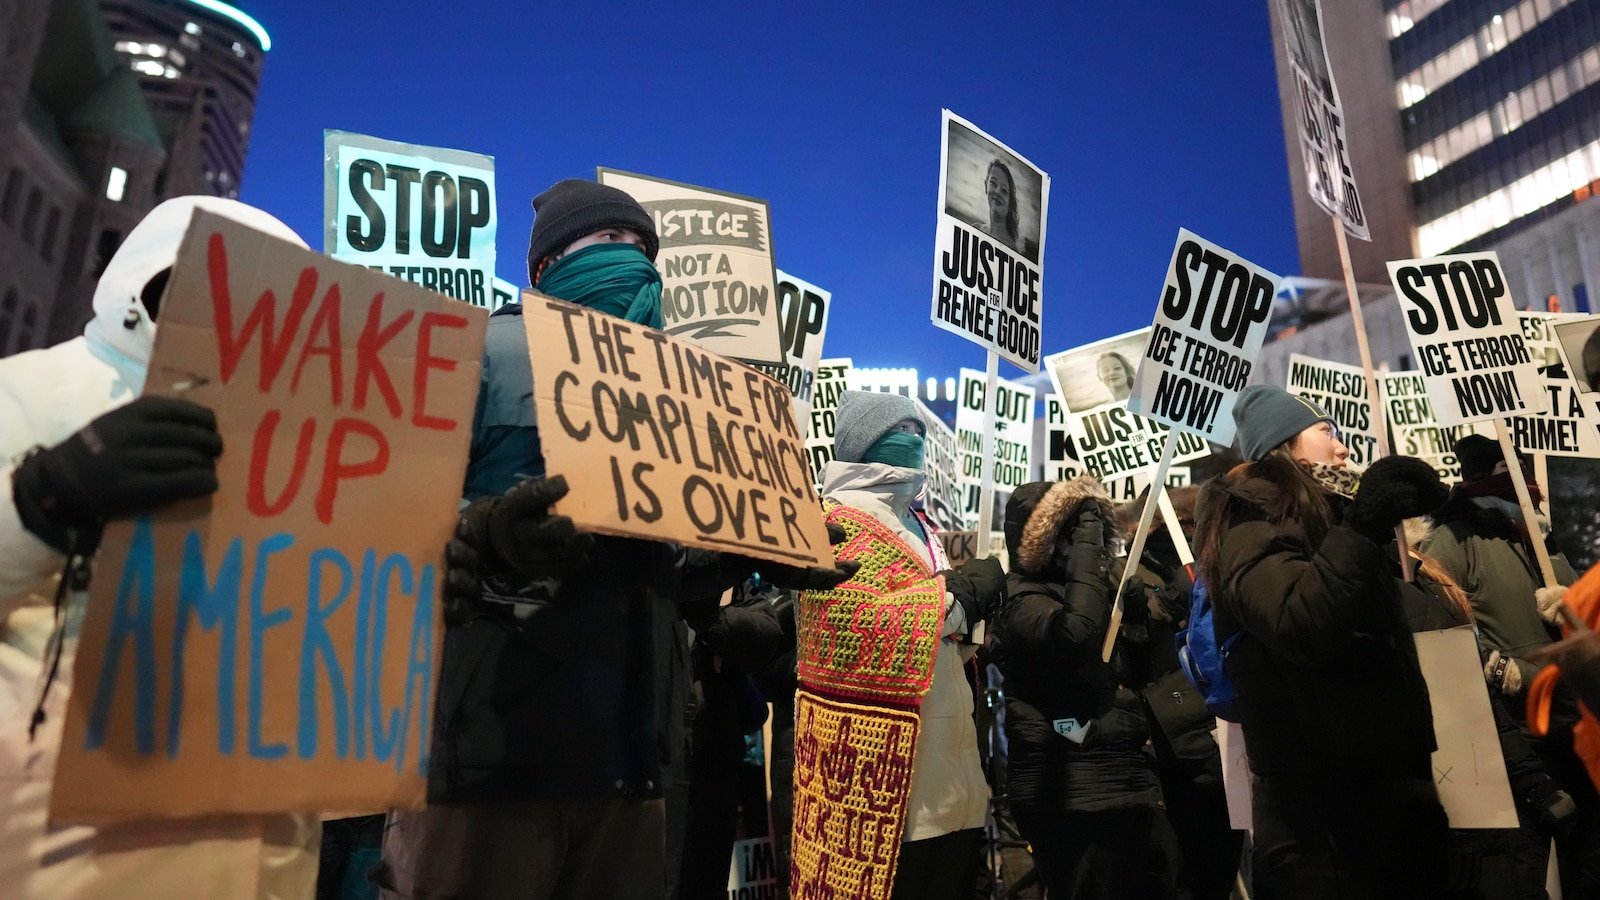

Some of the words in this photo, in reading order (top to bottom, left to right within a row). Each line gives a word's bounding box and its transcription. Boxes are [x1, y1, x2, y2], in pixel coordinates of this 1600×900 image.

[346, 158, 490, 260] STOP
[665, 253, 712, 278] NOT
[715, 253, 732, 276] A
[942, 225, 1040, 324] JUSTICE
[989, 291, 1000, 308] FOR
[1162, 240, 1275, 349] STOP
[1396, 259, 1505, 336] STOP
[208, 233, 468, 431] WAKE
[662, 280, 769, 325] MOTION
[937, 279, 994, 342] RENEE
[997, 309, 1040, 365] GOOD
[546, 302, 641, 382] THE
[643, 330, 743, 417] TIME
[744, 372, 800, 440] FOR
[1146, 323, 1182, 367] ICE
[1180, 336, 1252, 393] TERROR
[1291, 362, 1380, 401] MINNESOT
[1418, 344, 1457, 377] ICE
[1453, 334, 1531, 372] TERROR
[995, 386, 1032, 424] OUT
[1151, 371, 1224, 434] NOW!
[1452, 371, 1526, 418] NOW!
[1569, 386, 1585, 418] A
[247, 409, 390, 525] UP
[554, 371, 815, 502] COMPLACENCY
[1083, 444, 1149, 481] RENEE
[1131, 434, 1145, 443] FOR
[610, 456, 663, 523] IS
[682, 475, 811, 550] OVER
[85, 513, 435, 779] AMERICA
